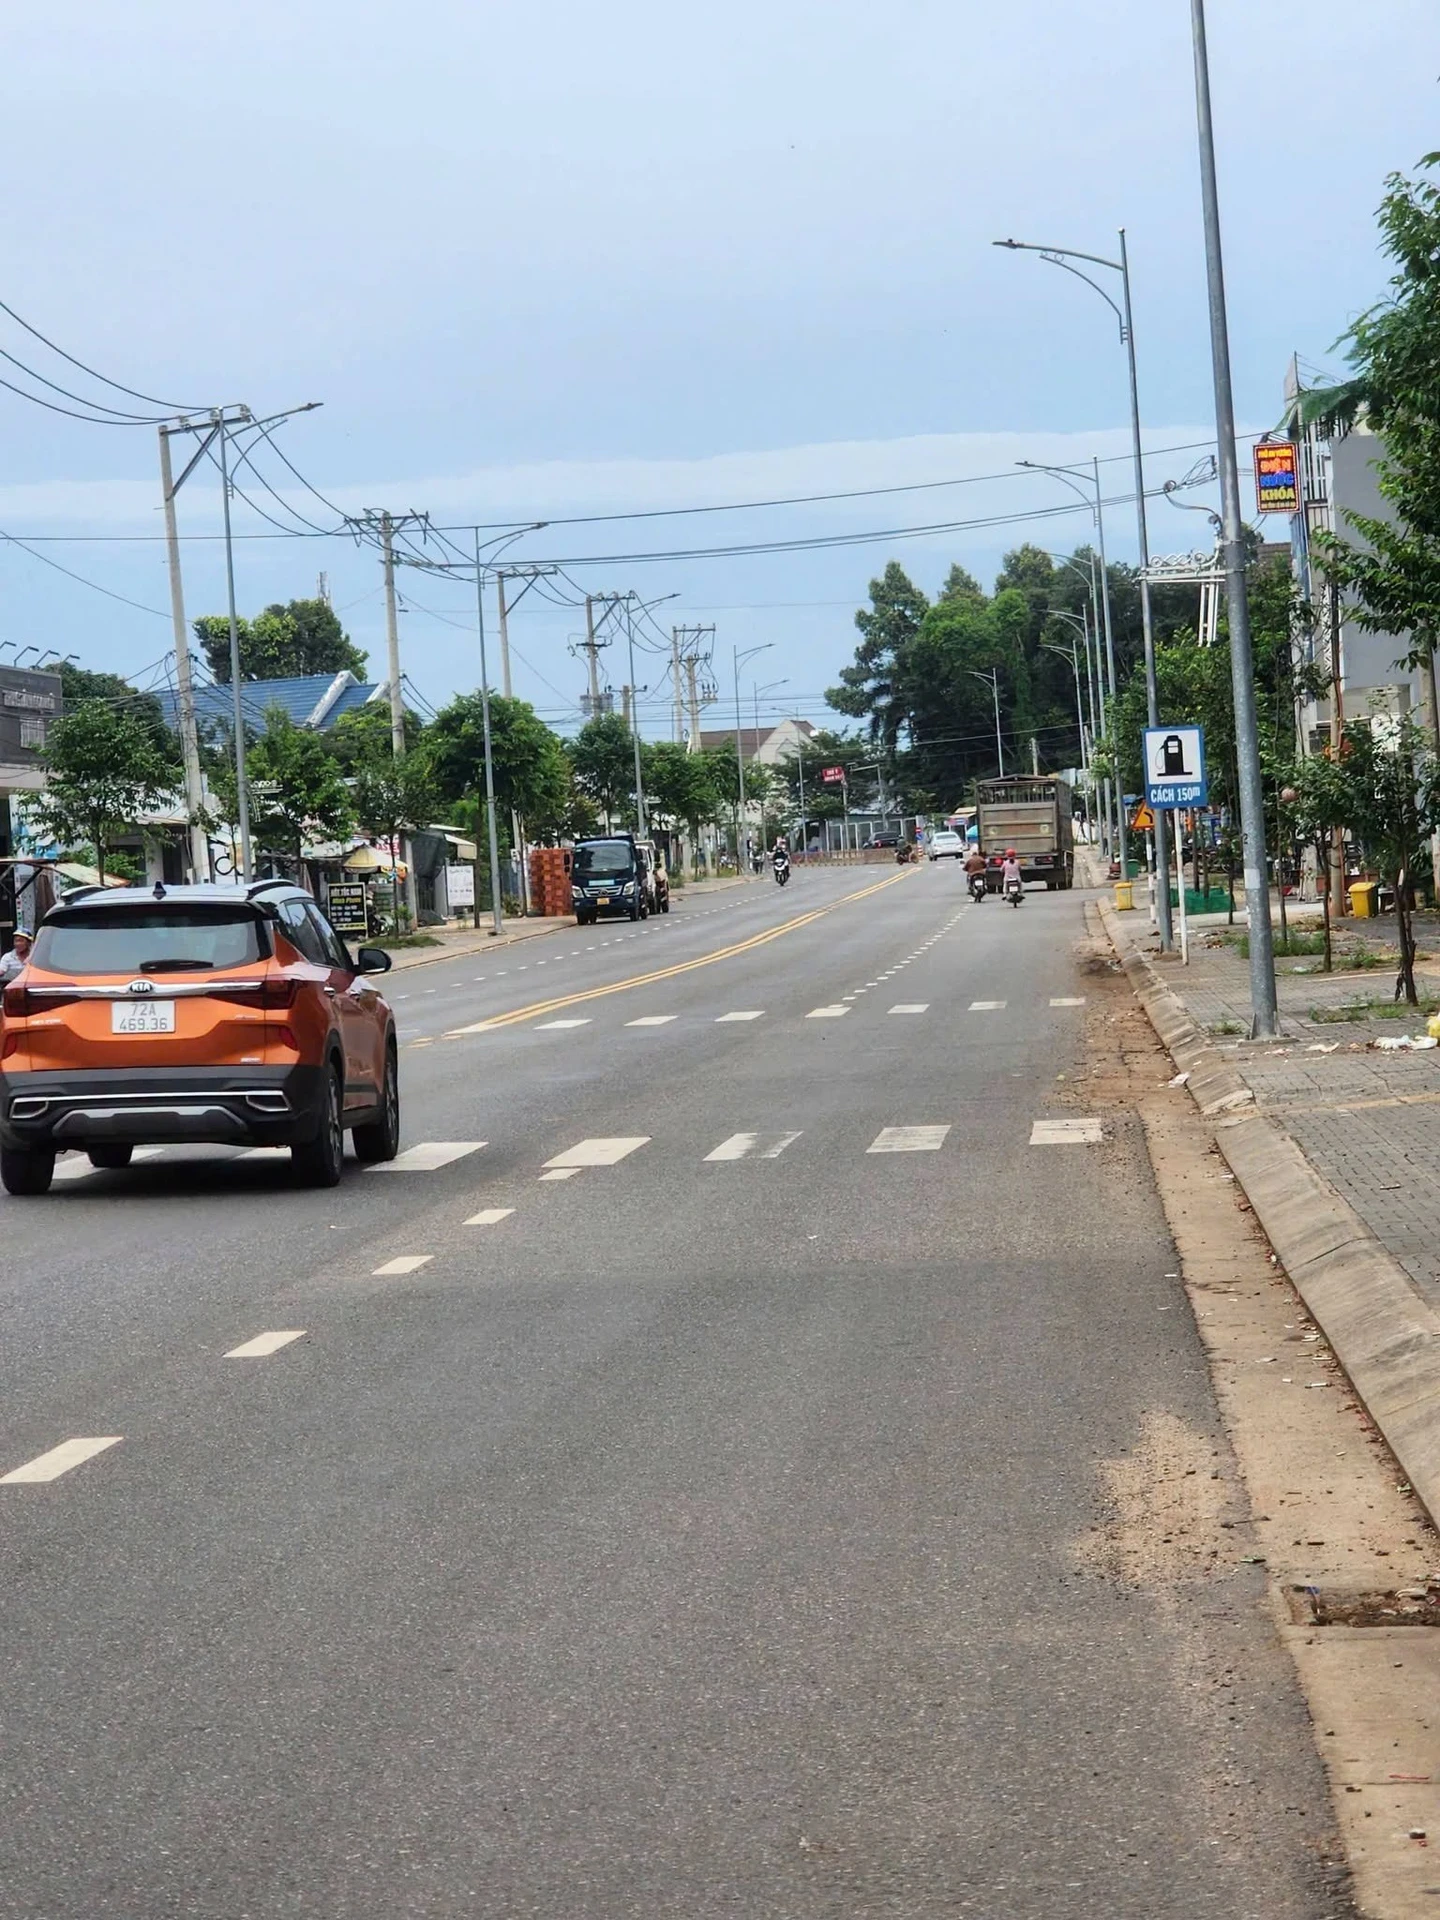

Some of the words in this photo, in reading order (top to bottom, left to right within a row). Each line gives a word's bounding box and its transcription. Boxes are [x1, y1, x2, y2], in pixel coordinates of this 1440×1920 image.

[1261, 486, 1295, 501] KHÓA
[1150, 785, 1175, 803] CÁCH
[1177, 786, 1200, 801] 150m
[131, 982, 151, 992] KIA
[130, 1003, 156, 1016] 72A
[119, 1017, 168, 1031] 469.36
